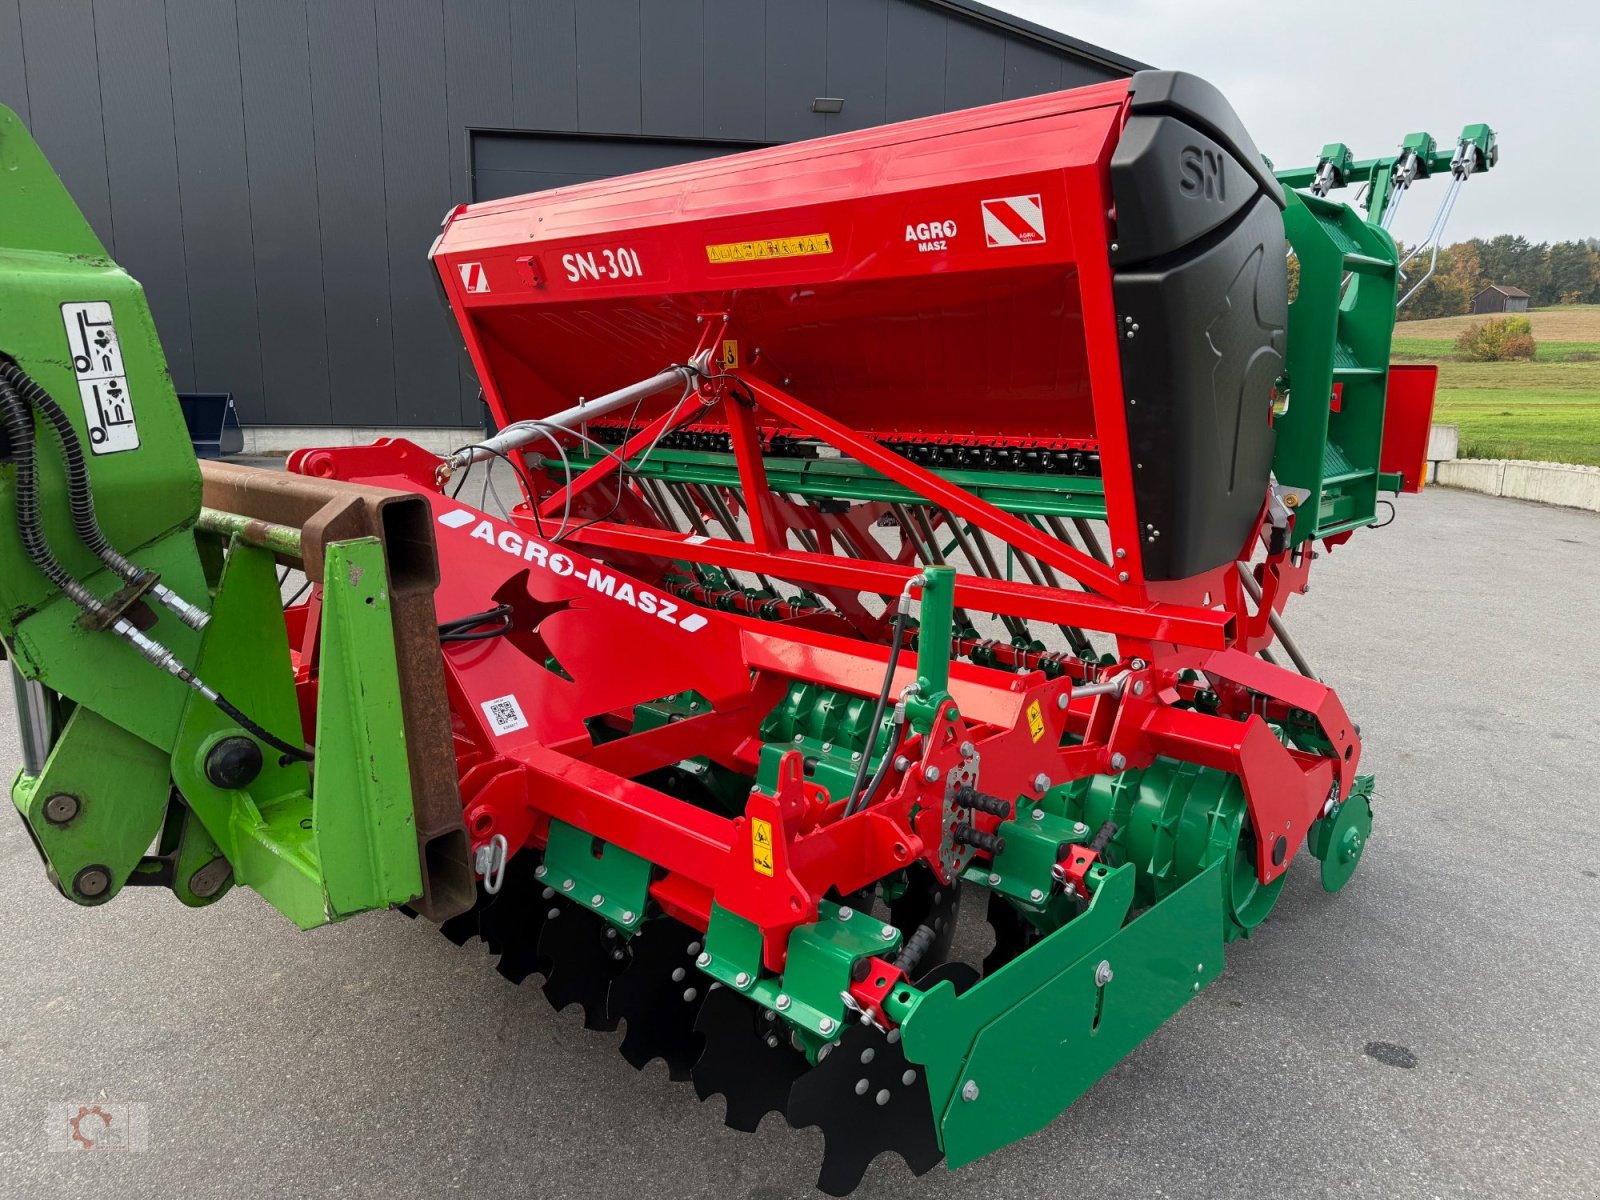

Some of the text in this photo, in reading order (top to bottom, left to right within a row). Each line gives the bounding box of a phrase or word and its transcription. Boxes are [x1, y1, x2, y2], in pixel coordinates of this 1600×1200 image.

[1179, 145, 1226, 203] SN
[905, 219, 957, 242] AGRO
[918, 240, 948, 252] MASZ
[470, 520, 677, 625] AGRO-MASZ
